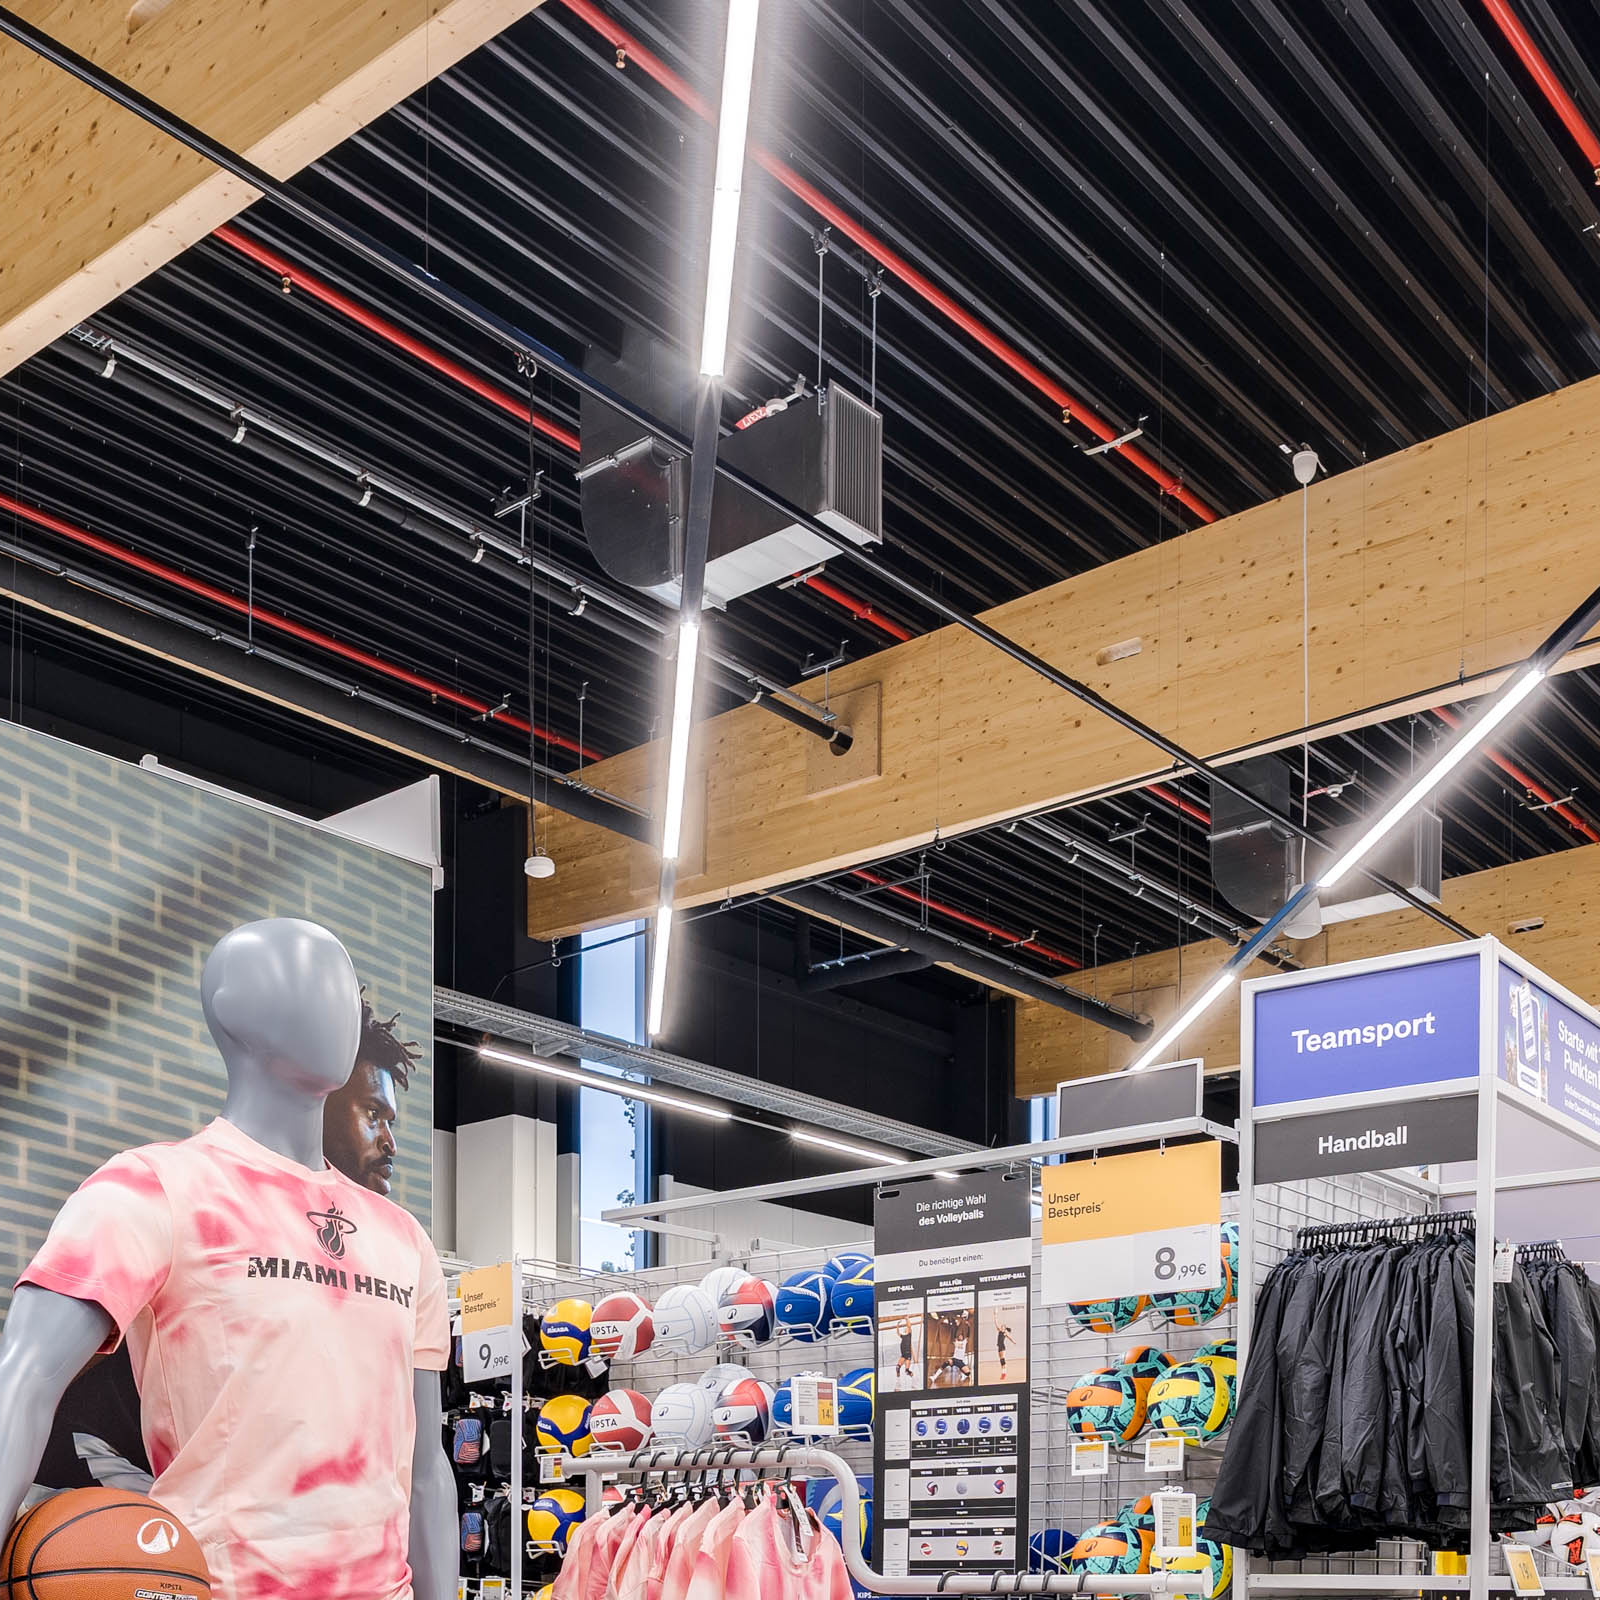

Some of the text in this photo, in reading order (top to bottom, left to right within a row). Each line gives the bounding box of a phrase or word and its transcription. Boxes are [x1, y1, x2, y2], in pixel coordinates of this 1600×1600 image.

[1291, 1012, 1436, 1054] Teamsport
[1558, 1020, 1585, 1054] Starte
[1318, 1126, 1408, 1155] Handball
[916, 1194, 987, 1213] Die richtige Wahl
[1048, 1192, 1080, 1205] Unser
[918, 1209, 984, 1226] des Volleyballs
[1048, 1203, 1102, 1219] Bestpreis
[919, 1253, 984, 1267] Du benötigst einen:
[1154, 1247, 1207, 1281] 8,99€
[248, 1257, 414, 1309] MIAMI HEAT
[464, 1291, 484, 1303] Unser
[464, 1300, 497, 1314] Bestpreis
[479, 1343, 510, 1370] 9,99€
